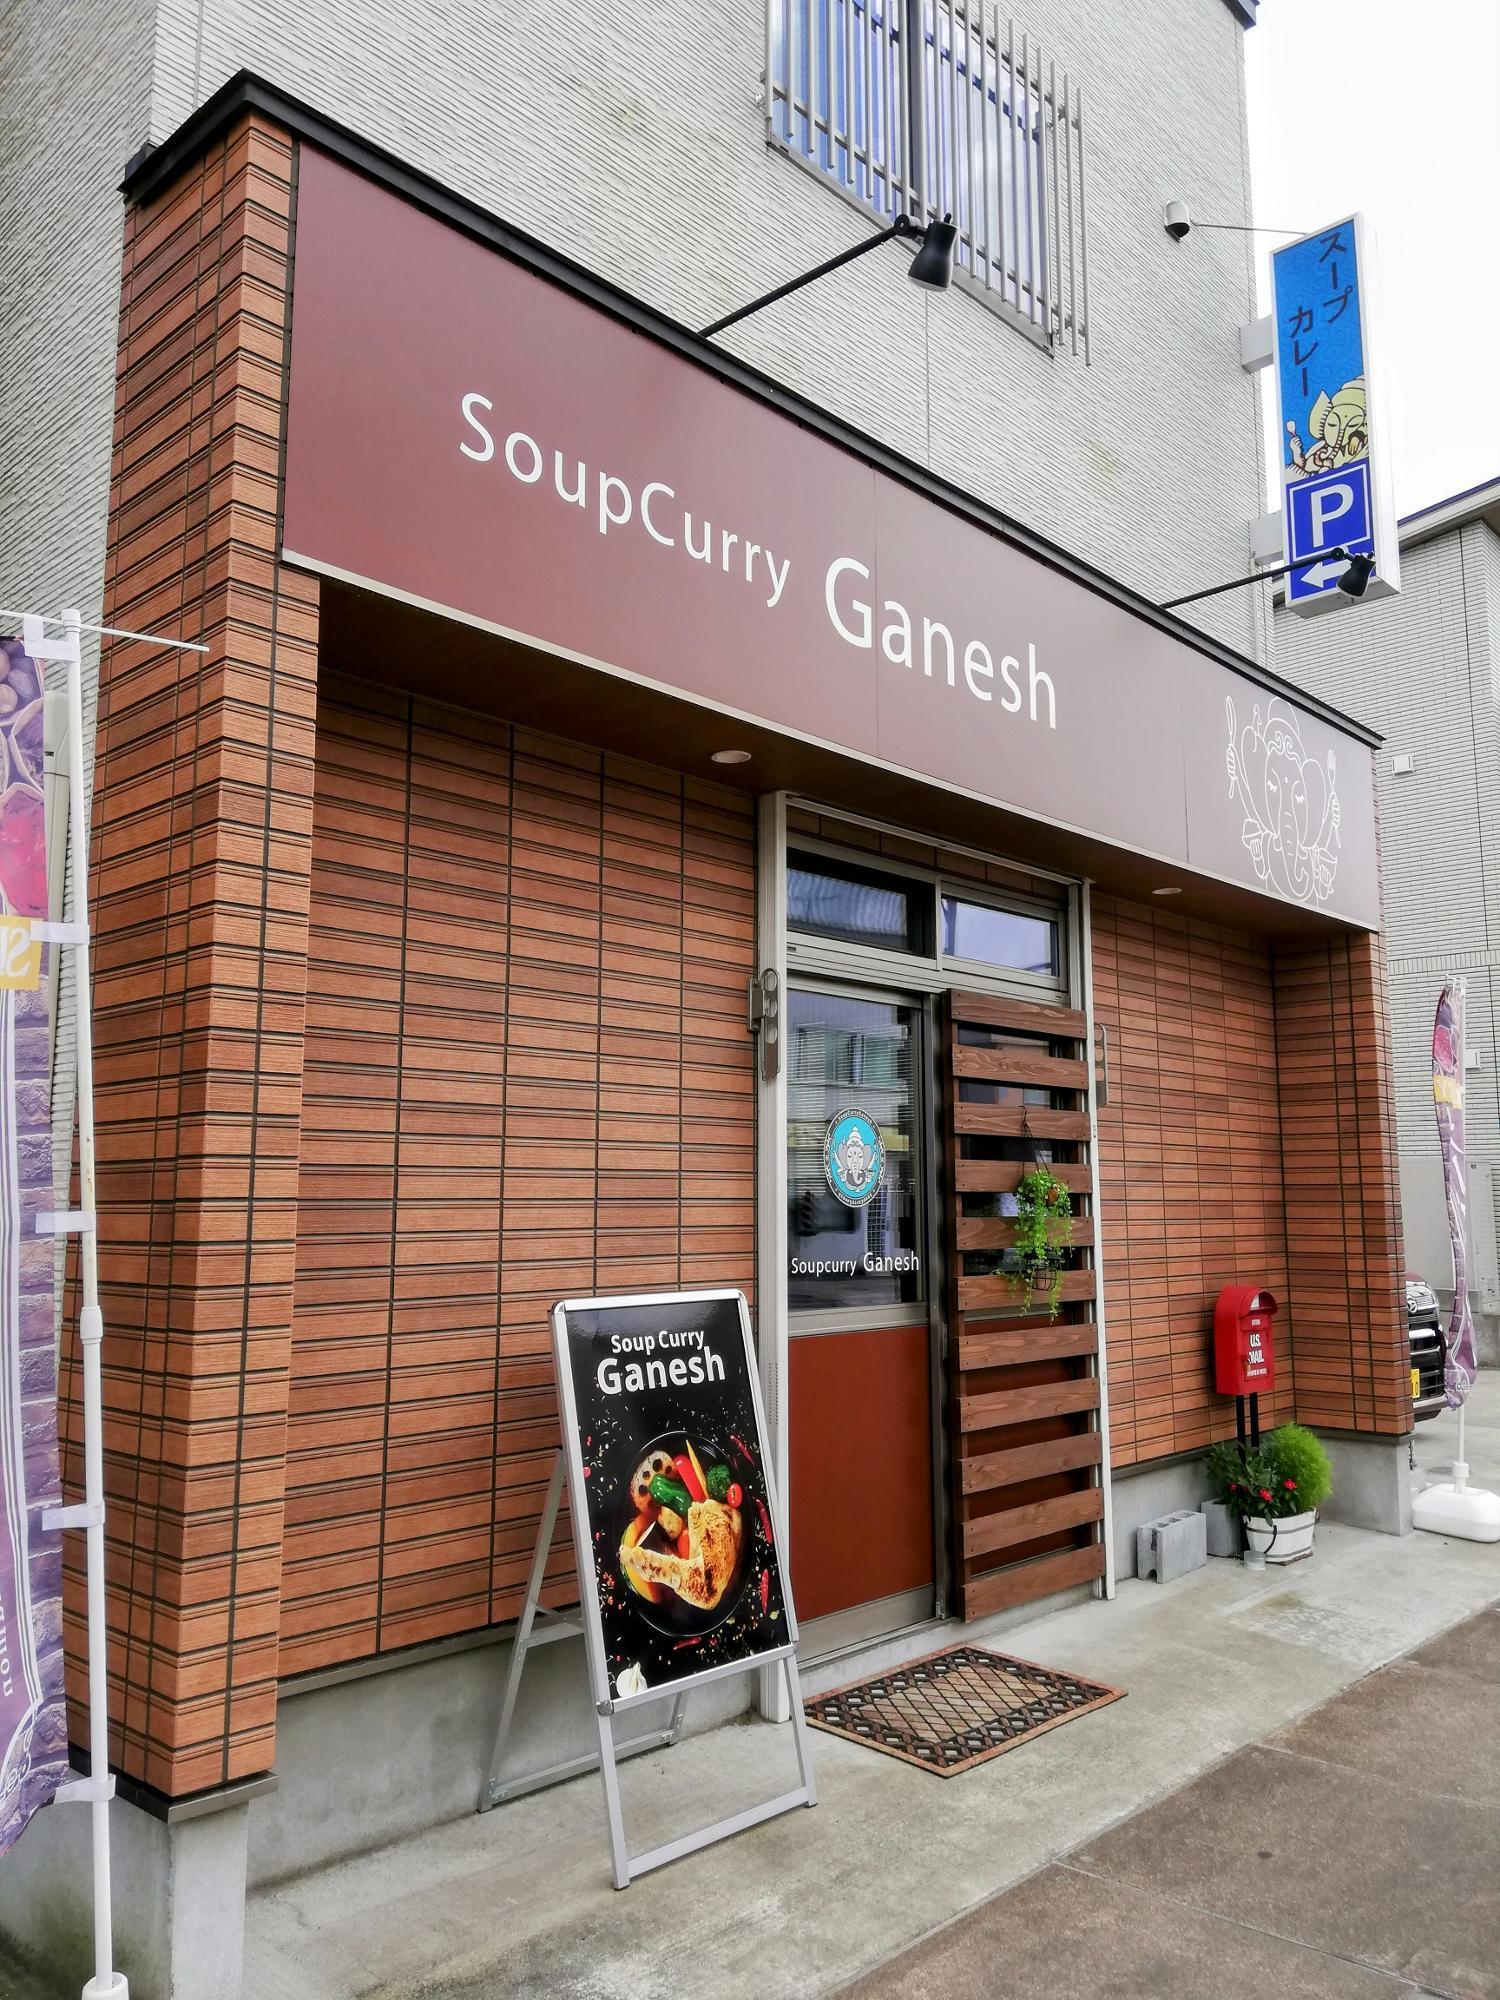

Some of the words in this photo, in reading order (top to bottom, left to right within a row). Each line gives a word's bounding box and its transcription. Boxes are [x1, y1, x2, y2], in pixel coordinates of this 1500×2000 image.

[1319, 231, 1353, 325] スープ
[1288, 305, 1318, 397] カレー
[1310, 483, 1354, 549] P
[459, 392, 791, 608] SoupCurry
[825, 557, 1056, 730] Ganesh
[791, 1257, 857, 1278] Soupcurry
[863, 1250, 920, 1272] Ganesh
[597, 1345, 726, 1395] Ganesh
[611, 1334, 656, 1356] Soup
[658, 1330, 704, 1350] Curry
